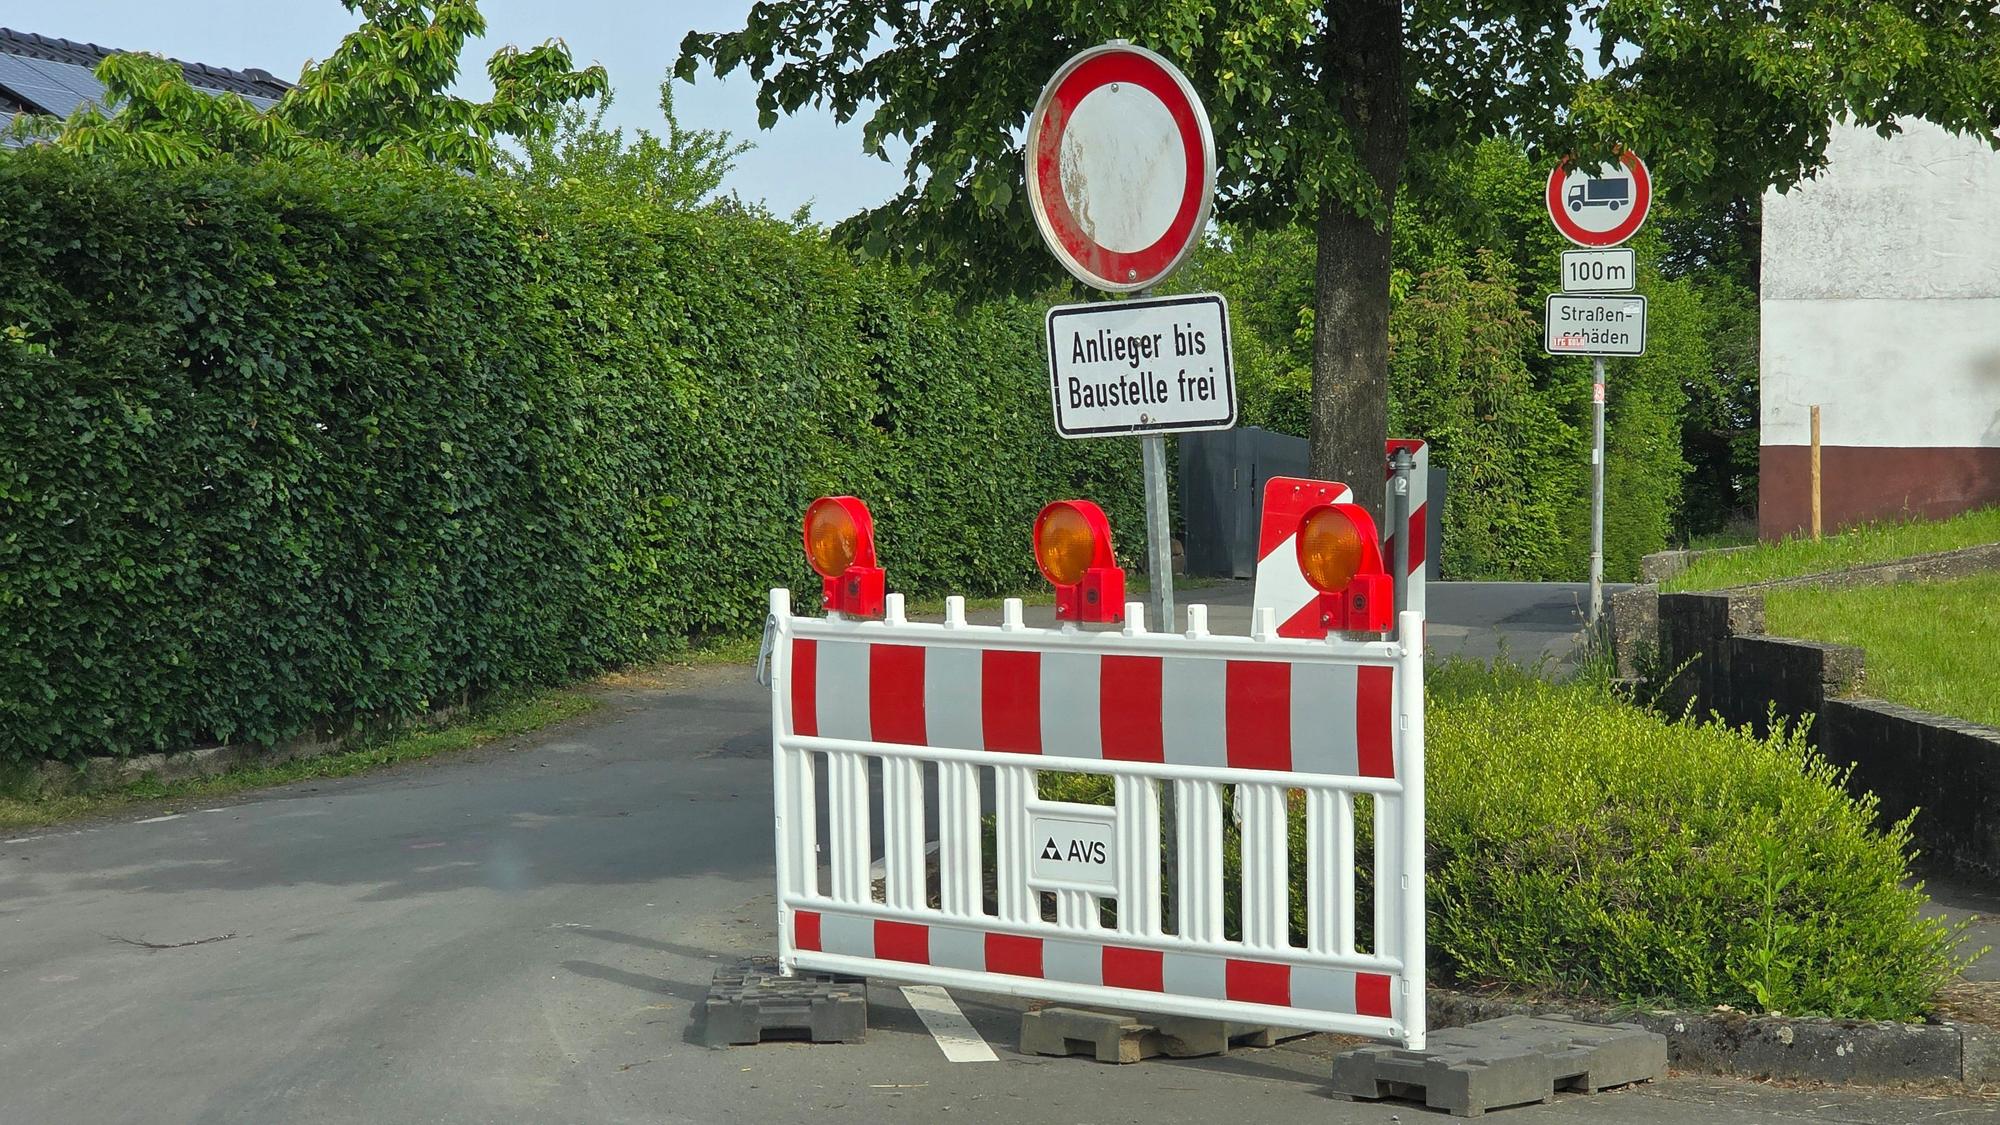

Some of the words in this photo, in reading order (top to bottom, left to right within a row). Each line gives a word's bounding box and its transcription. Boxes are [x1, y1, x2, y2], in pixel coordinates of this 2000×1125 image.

[1560, 305, 1632, 322] Straßen-
[1072, 328, 1162, 369] Anlieger
[1173, 322, 1206, 357] bis
[1068, 371, 1168, 409] Baustelle
[1178, 367, 1216, 402] frei
[1067, 839, 1106, 864] AVS
